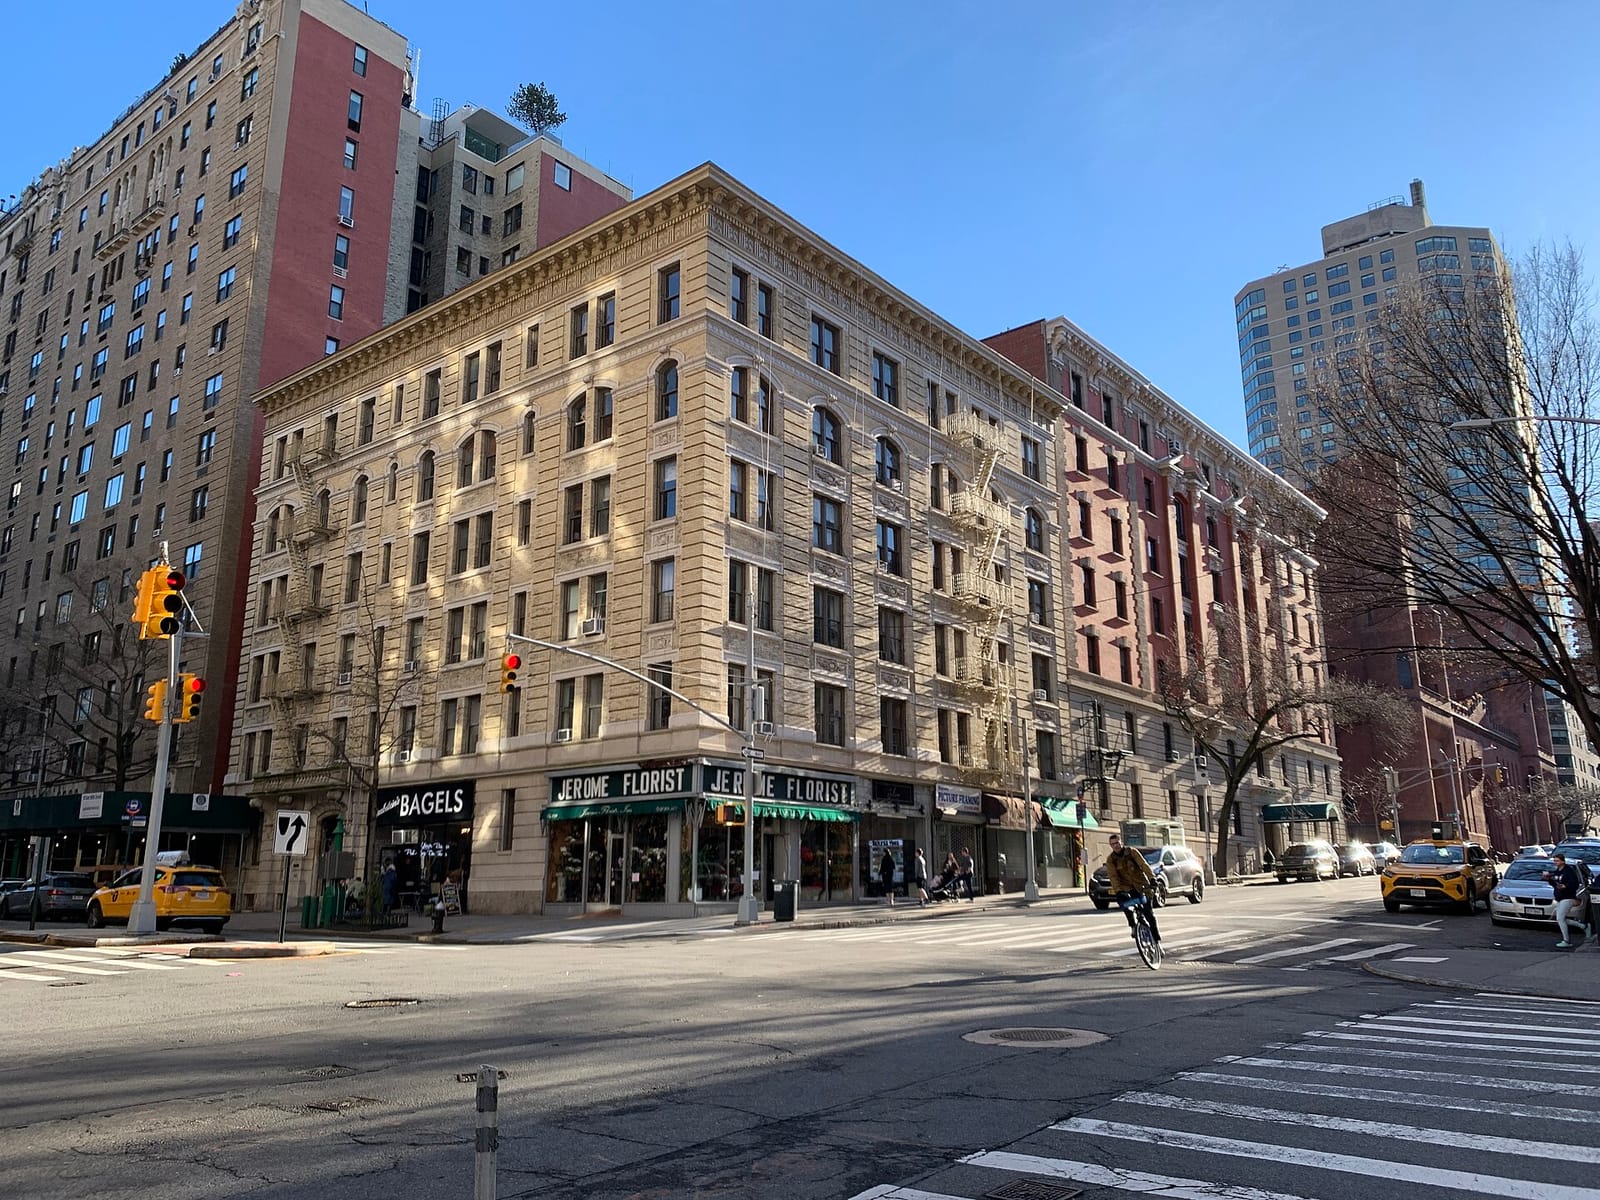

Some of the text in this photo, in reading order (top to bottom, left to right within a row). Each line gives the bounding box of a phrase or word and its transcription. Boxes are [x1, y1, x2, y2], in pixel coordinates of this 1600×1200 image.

[558, 768, 685, 801] JEROME FLORIST
[711, 769, 848, 804] JERE FLORIST
[400, 789, 464, 817] BAGELS
